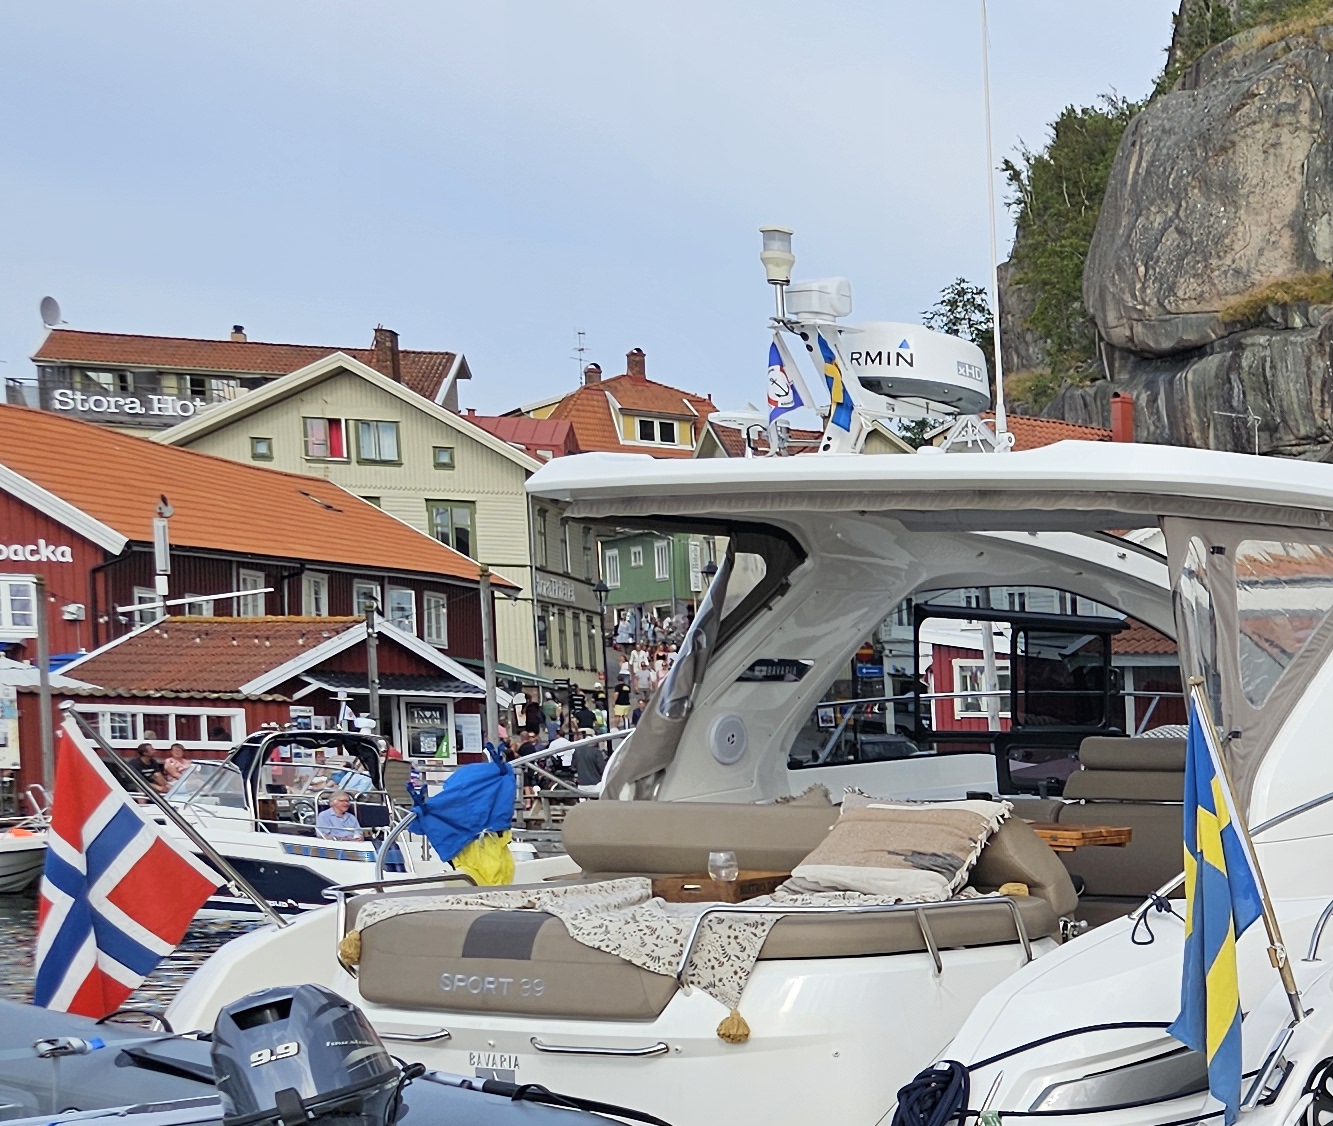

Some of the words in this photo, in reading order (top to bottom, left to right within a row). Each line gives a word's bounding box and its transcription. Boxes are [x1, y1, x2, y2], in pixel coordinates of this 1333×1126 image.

[958, 364, 983, 381] xHD
[53, 389, 146, 414] Stora
[0, 538, 73, 563] acka
[440, 973, 514, 996] SPORT
[519, 978, 545, 997] 39
[250, 1041, 299, 1067] 9.9
[469, 1052, 521, 1070] BAVARIA
